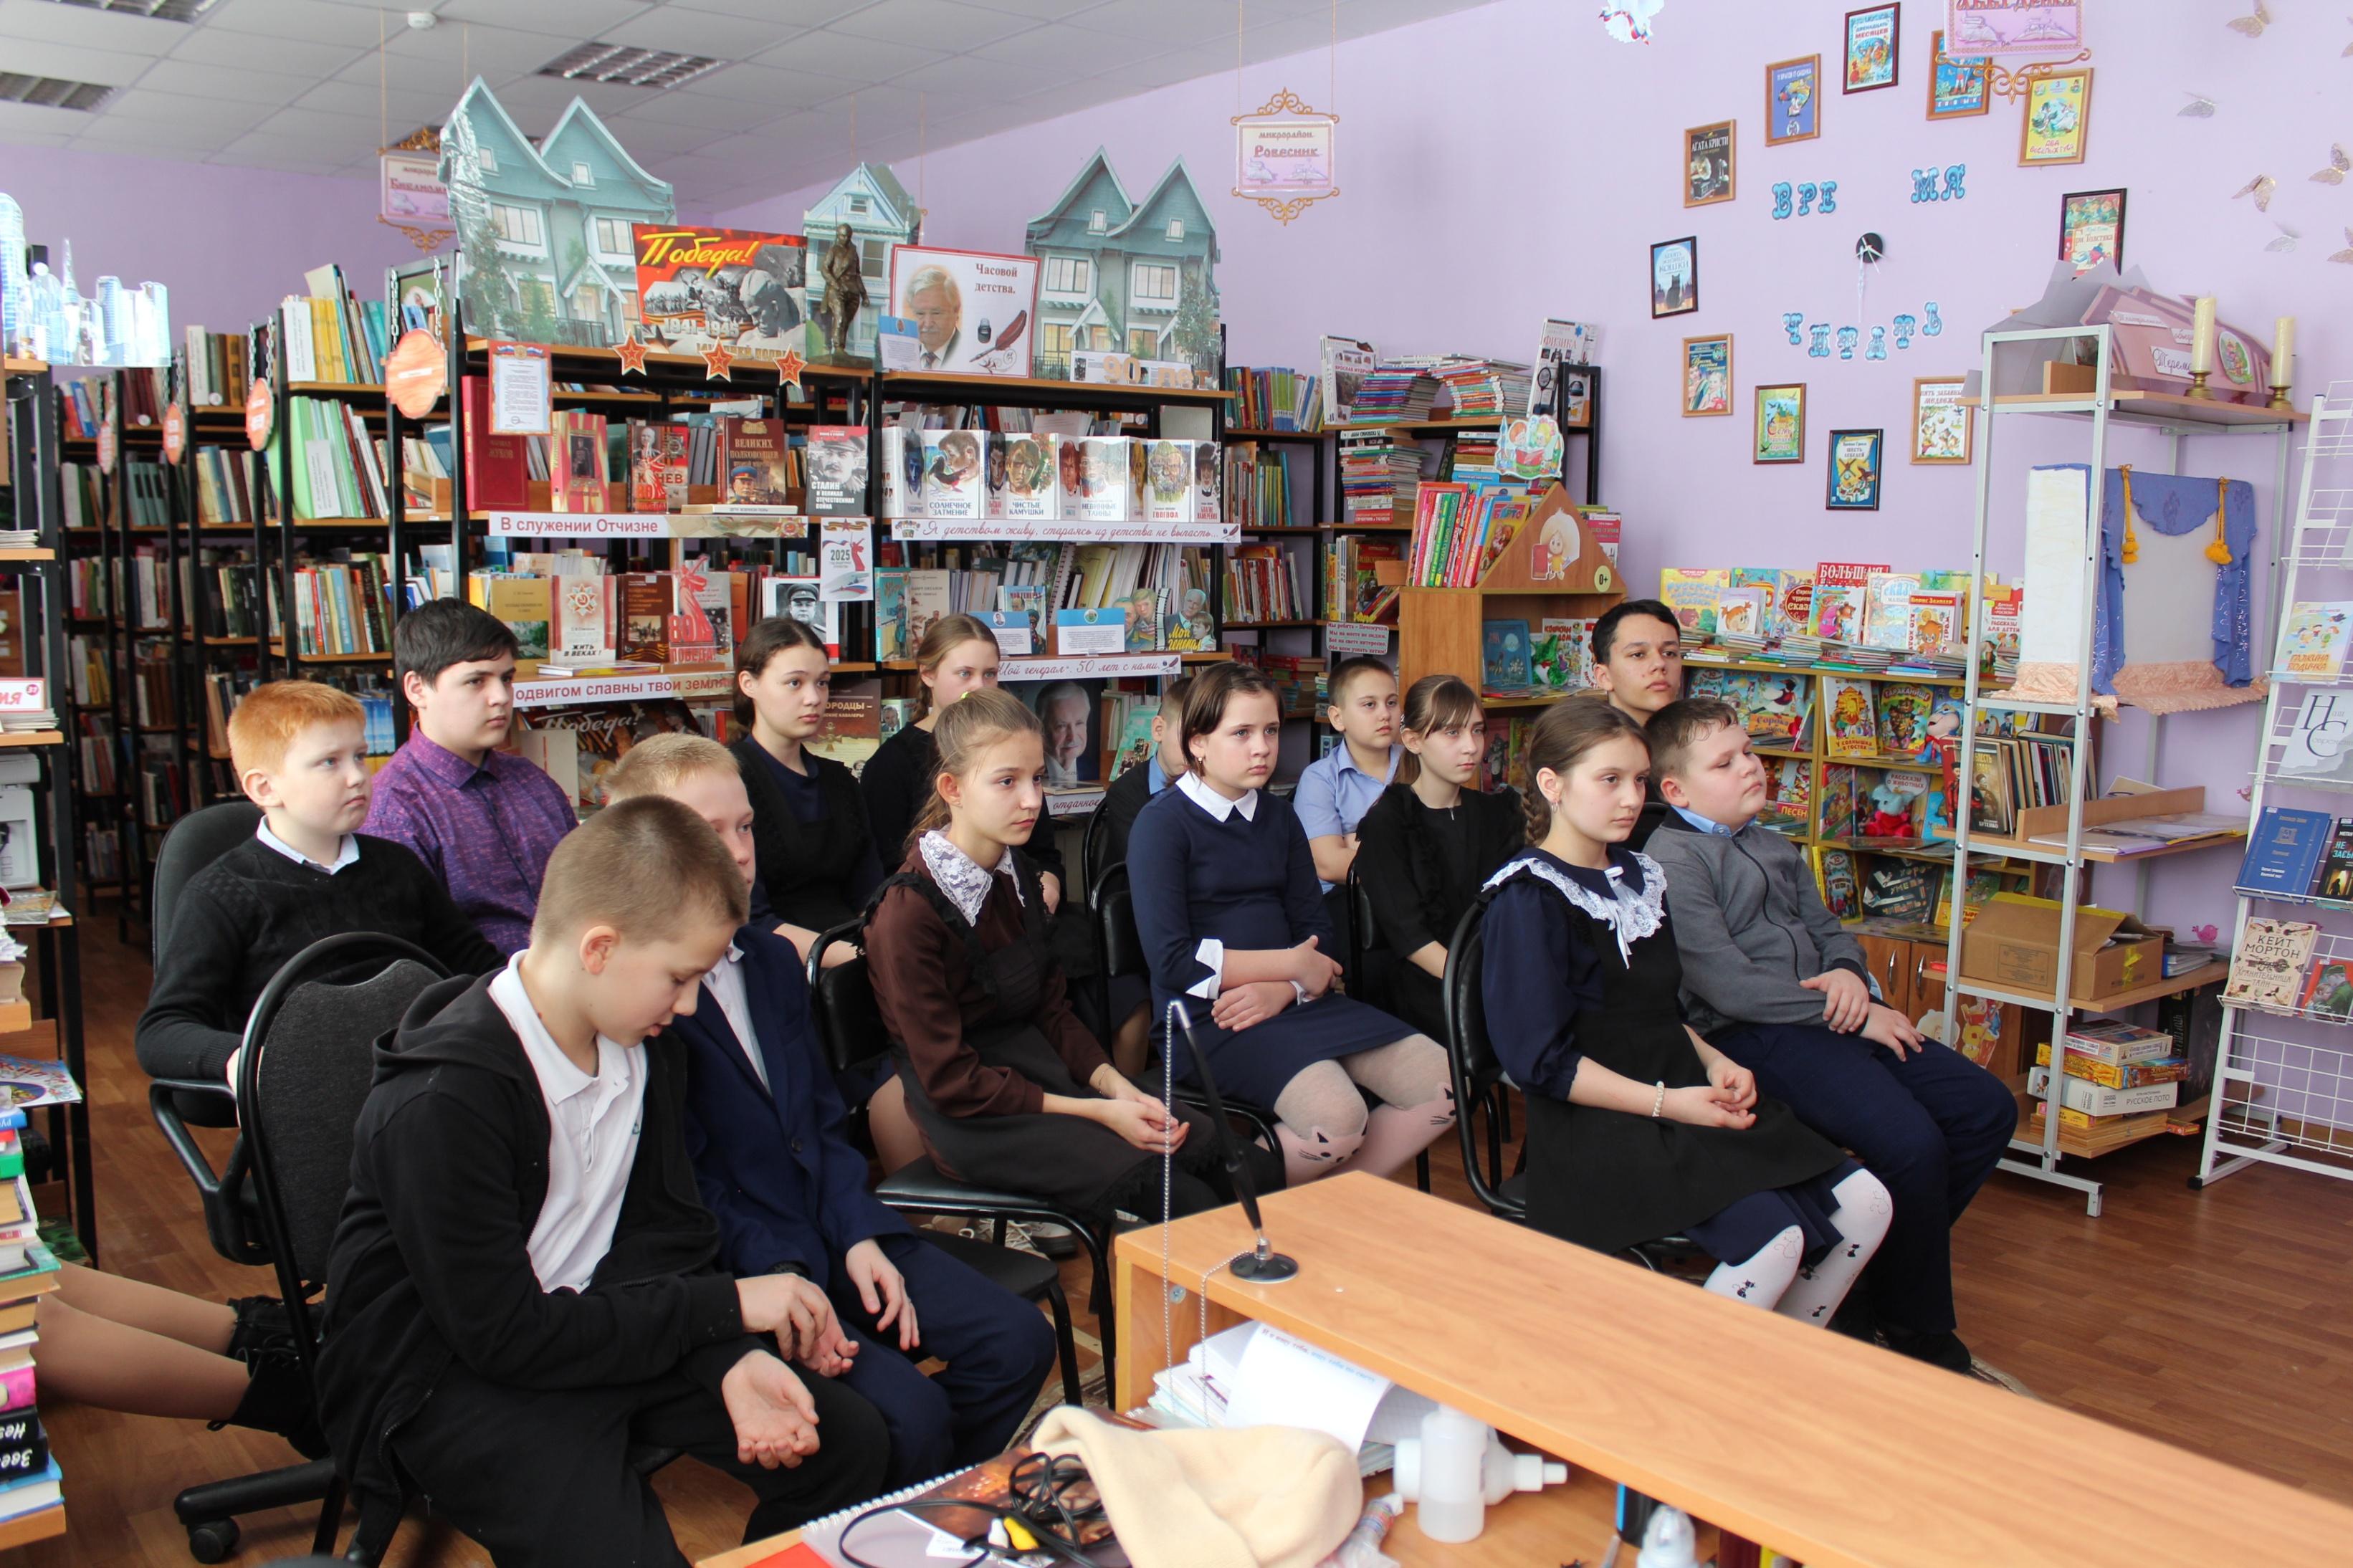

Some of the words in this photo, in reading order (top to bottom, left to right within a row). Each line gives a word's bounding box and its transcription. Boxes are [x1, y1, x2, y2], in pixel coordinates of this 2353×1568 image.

[1855, 28, 1889, 38] МЕСЯЦЕВ
[1259, 130, 1313, 140] микрорайон
[1691, 139, 1708, 152] АГАТА
[1709, 136, 1728, 148] КРИСТИ
[640, 232, 759, 279] Победа!
[975, 262, 1018, 278] Часовой
[1659, 262, 1689, 272] КОШКИ
[974, 281, 1016, 294] детства.
[1782, 301, 1942, 360] ЧИТАТЬ
[1544, 335, 1577, 348] ФИЗИКА
[1102, 354, 1141, 384] 90
[1158, 366, 1210, 388] лет
[734, 439, 773, 449] ВЕЛИКИХ
[638, 473, 683, 484] КНЕВ
[811, 482, 840, 490] СТАЛИН
[501, 517, 511, 530] В
[517, 519, 591, 534] служении
[596, 519, 658, 532] Отчизне
[923, 521, 938, 535] Я
[943, 521, 1001, 539] детством
[1006, 522, 1038, 539] живу,
[1043, 527, 1091, 540] стараясь
[1095, 530, 1106, 540] из
[1111, 525, 1152, 541] детства
[831, 549, 850, 561] 2025
[1599, 575, 1608, 585] 0+
[669, 614, 693, 643] 80
[1077, 660, 1094, 673] 50
[516, 686, 581, 702] одвигом
[586, 682, 642, 695] славны
[648, 682, 680, 692] твои
[1884, 687, 1930, 702] ТАРАКАНИЩЕ
[826, 702, 864, 711] ОРОДЦЫ
[1893, 780, 1924, 788] ЖИВОТНЫХ
[1053, 799, 1100, 810] отданное
[1781, 805, 1808, 818] ПЕСЕН
[2335, 841, 2347, 850] НЕ
[2258, 935, 2294, 948] КЕЙТ
[2245, 944, 2301, 959] МОРТОН
[2236, 967, 2291, 983] ХРАНИТЕЛЬНИЦА
[2252, 978, 2271, 988] ТАЙН
[2126, 1096, 2152, 1106] РУССКОЕ
